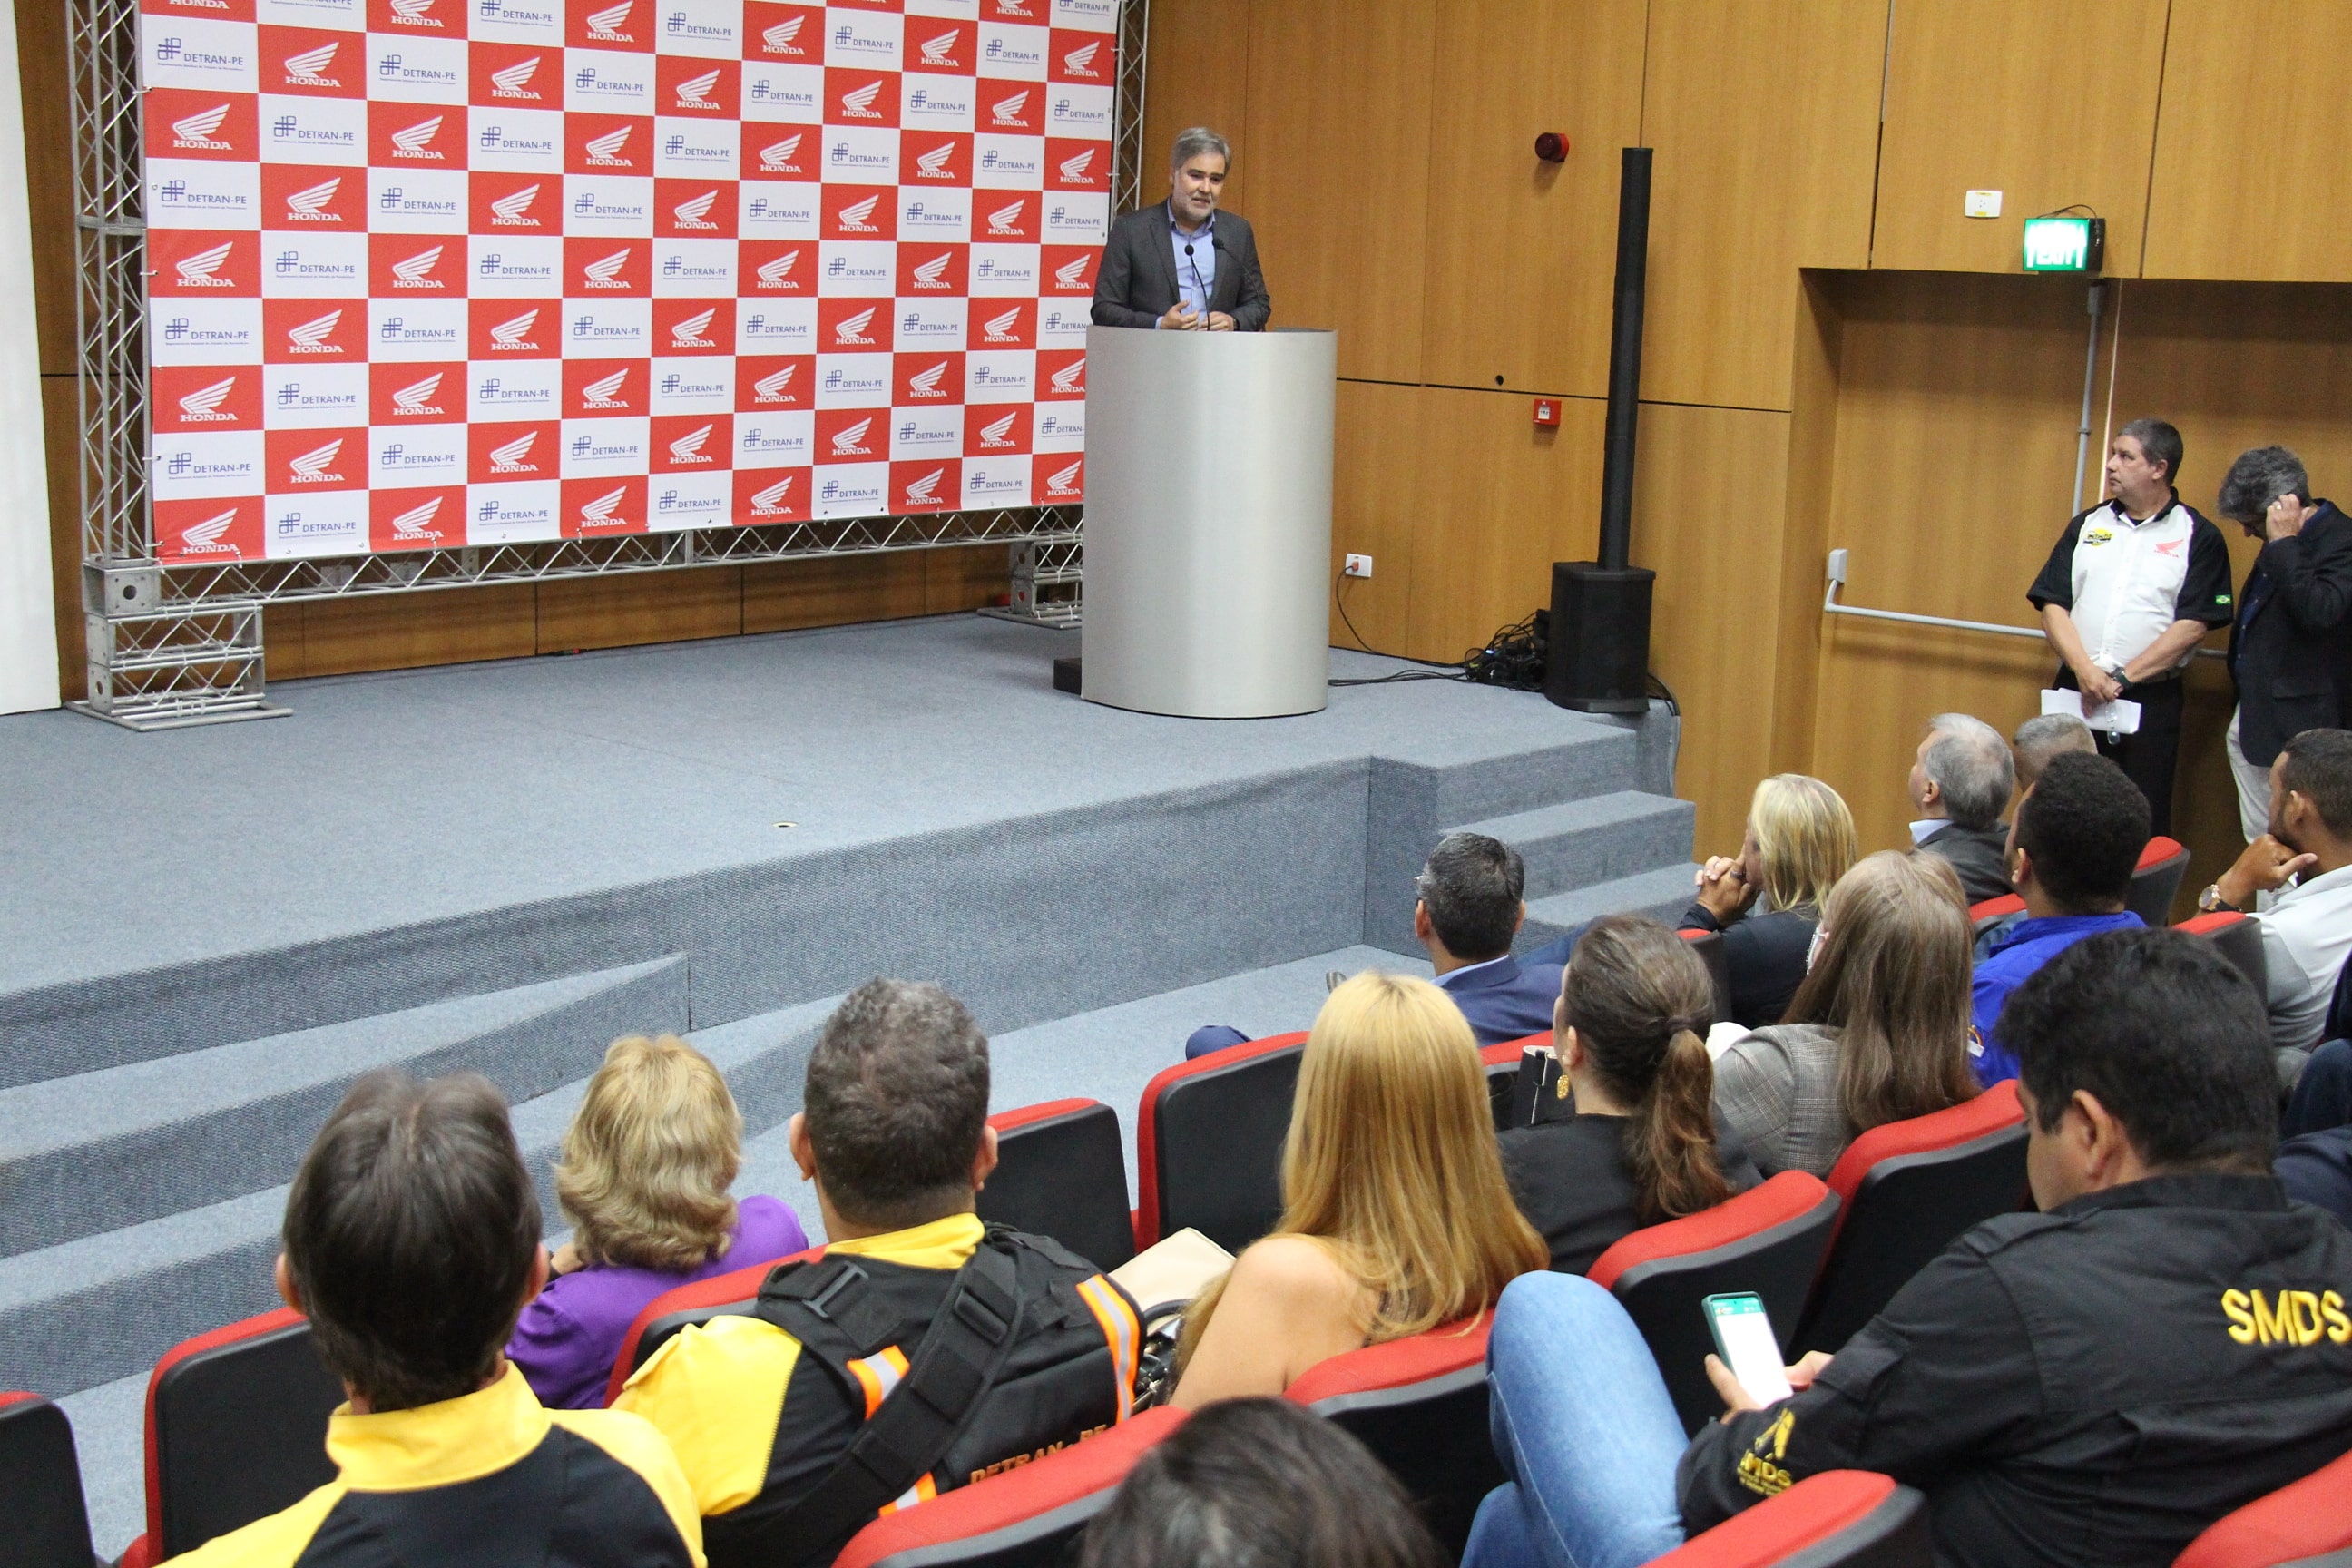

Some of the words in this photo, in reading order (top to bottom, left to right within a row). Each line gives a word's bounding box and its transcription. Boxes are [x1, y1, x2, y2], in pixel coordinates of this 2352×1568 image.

[503, 10, 552, 22] DETRAN-PE
[996, 7, 1034, 16] HONDA
[390, 15, 444, 27] HONDA
[687, 25, 731, 36] DETRAN-PE
[587, 31, 634, 42] HONDA
[852, 39, 893, 49] DETRAN-PE
[762, 45, 805, 55] HONDA
[184, 54, 243, 65] DETRAN-PE
[1003, 51, 1039, 60] DETRAN-PE
[920, 57, 959, 66] HONDA
[403, 69, 455, 80] DETRAN-PE
[1064, 68, 1100, 77] HONDA
[285, 76, 341, 87] HONDA
[596, 82, 643, 92] DETRAN-PE
[492, 89, 542, 99] HONDA
[770, 93, 813, 102] DETRAN-PE
[676, 100, 720, 110] HONDA
[927, 102, 965, 111] DETRAN-PE
[842, 110, 882, 118] HONDA
[1070, 111, 1105, 119] DETRAN-PE
[992, 118, 1029, 126] HONDA
[298, 130, 353, 141] DETRAN-PE
[174, 139, 233, 150] HONDA
[503, 140, 552, 149] DETRAN-PE
[392, 149, 445, 159] HONDA
[685, 148, 730, 157] DETRAN-PE
[586, 157, 632, 166] HONDA
[849, 155, 889, 163] DETRAN-PE
[760, 164, 802, 172] HONDA
[188, 194, 247, 204] DETRAN-PE
[404, 201, 456, 210] DETRAN-PE
[595, 206, 642, 214] DETRAN-PE
[287, 212, 343, 221] HONDA
[492, 218, 541, 226] HONDA
[299, 265, 355, 273] DETRAN-PE
[177, 279, 236, 287] HONDA
[191, 331, 249, 339] DETRAN-PE
[404, 329, 456, 338] DETRAN-PE
[491, 342, 540, 350] HONDA
[671, 339, 716, 348] HONDA
[289, 345, 344, 353] HONDA
[501, 389, 549, 398] DETRAN-PE
[681, 385, 724, 393] DETRAN-PE
[301, 395, 355, 404] DETRAN-PE
[754, 395, 796, 403] HONDA
[583, 400, 629, 408] HONDA
[393, 407, 445, 415] HONDA
[180, 412, 238, 422] HONDA
[916, 431, 954, 439] DETRAN-PE
[761, 438, 803, 446] DETRAN-PE
[592, 446, 638, 455] DETRAN-PE
[832, 447, 872, 456] HONDA
[404, 454, 455, 464] DETRAN-PE
[670, 455, 713, 464] HONDA
[193, 463, 250, 473] DETRAN-PE
[490, 464, 538, 473] HONDA
[290, 473, 344, 483] HONDA
[986, 480, 1023, 488] DETRAN-PE
[839, 488, 878, 497] DETRAN-PE
[678, 498, 721, 507] DETRAN-PE
[906, 496, 944, 505] HONDA
[500, 509, 548, 519] DETRAN-PE
[751, 506, 793, 515] HONDA
[302, 521, 356, 532] DETRAN-PE
[581, 517, 627, 527] HONDA
[393, 529, 444, 540] HONDA
[182, 543, 240, 554] HONDA
[2221, 1289, 2352, 1347] SMDS
